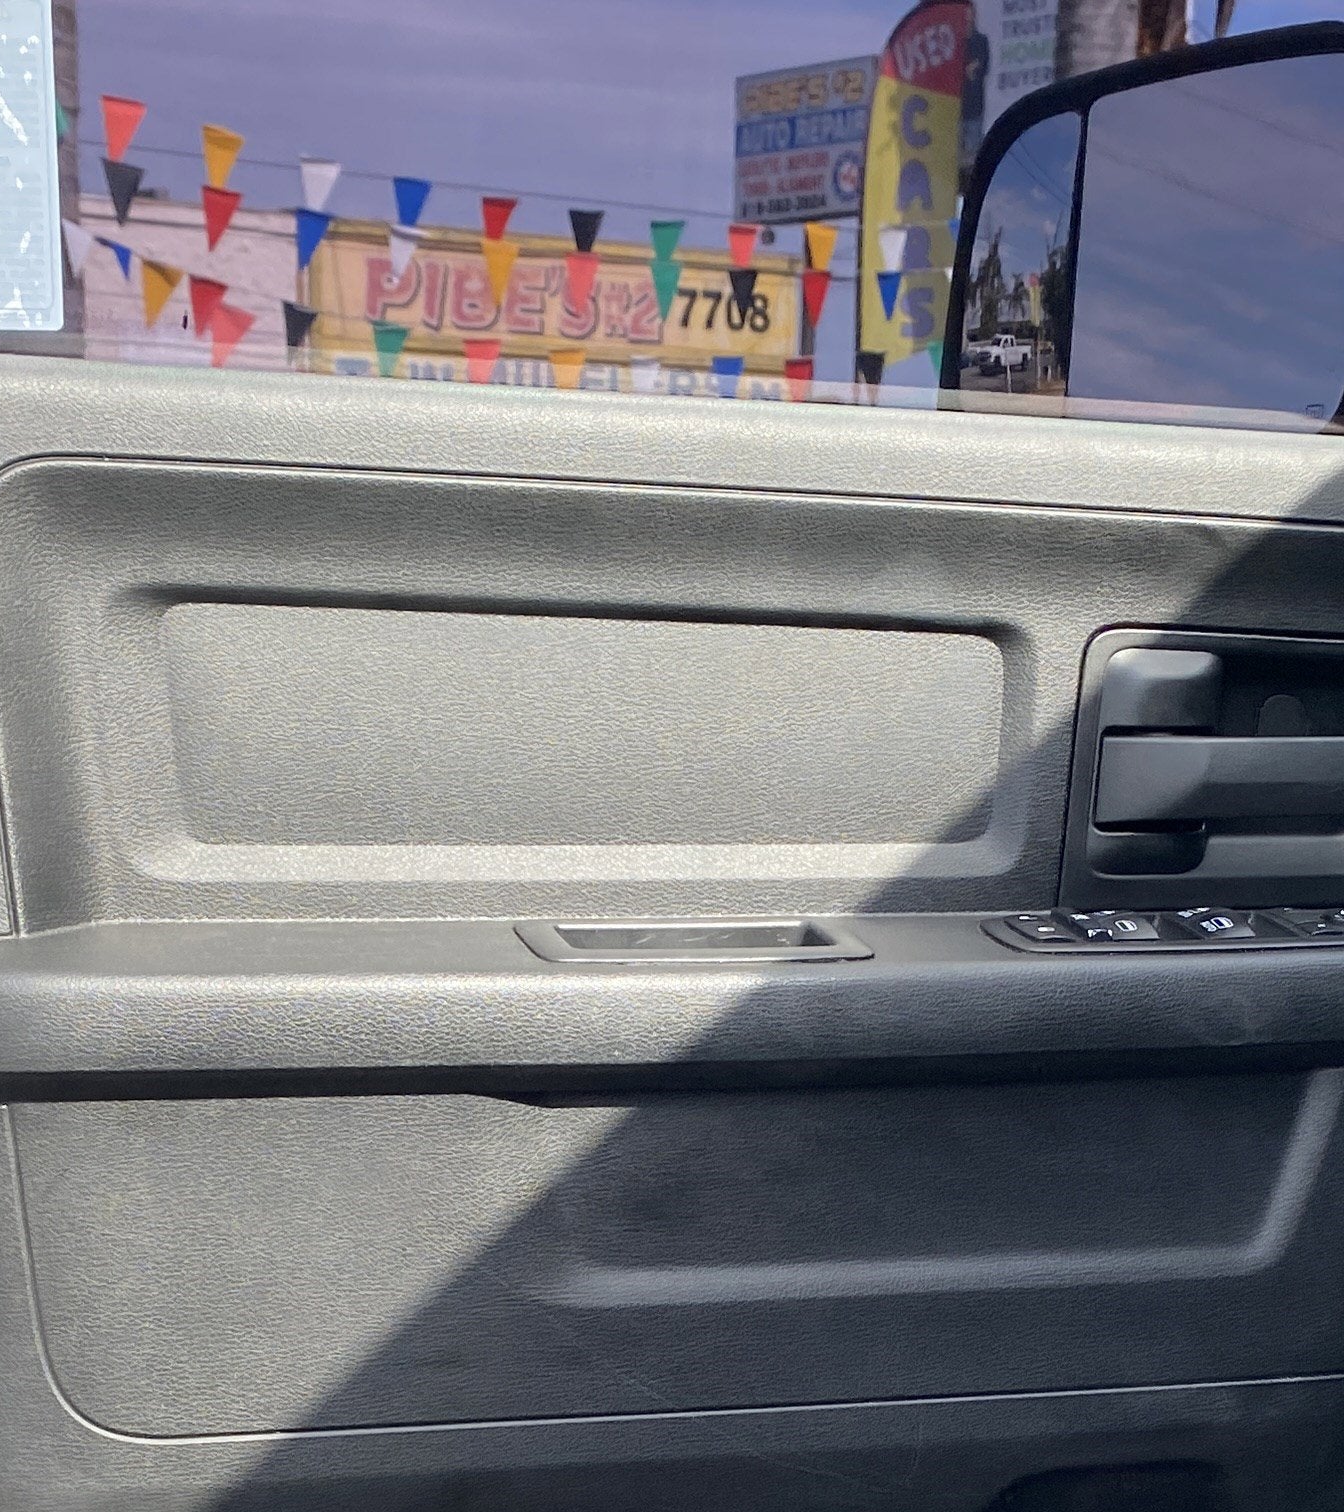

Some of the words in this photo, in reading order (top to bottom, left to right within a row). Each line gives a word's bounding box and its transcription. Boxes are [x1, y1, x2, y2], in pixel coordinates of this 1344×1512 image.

[893, 23, 955, 80] USED
[739, 118, 790, 152] AUTO
[896, 94, 935, 338] CARS
[677, 287, 772, 333] 7708
